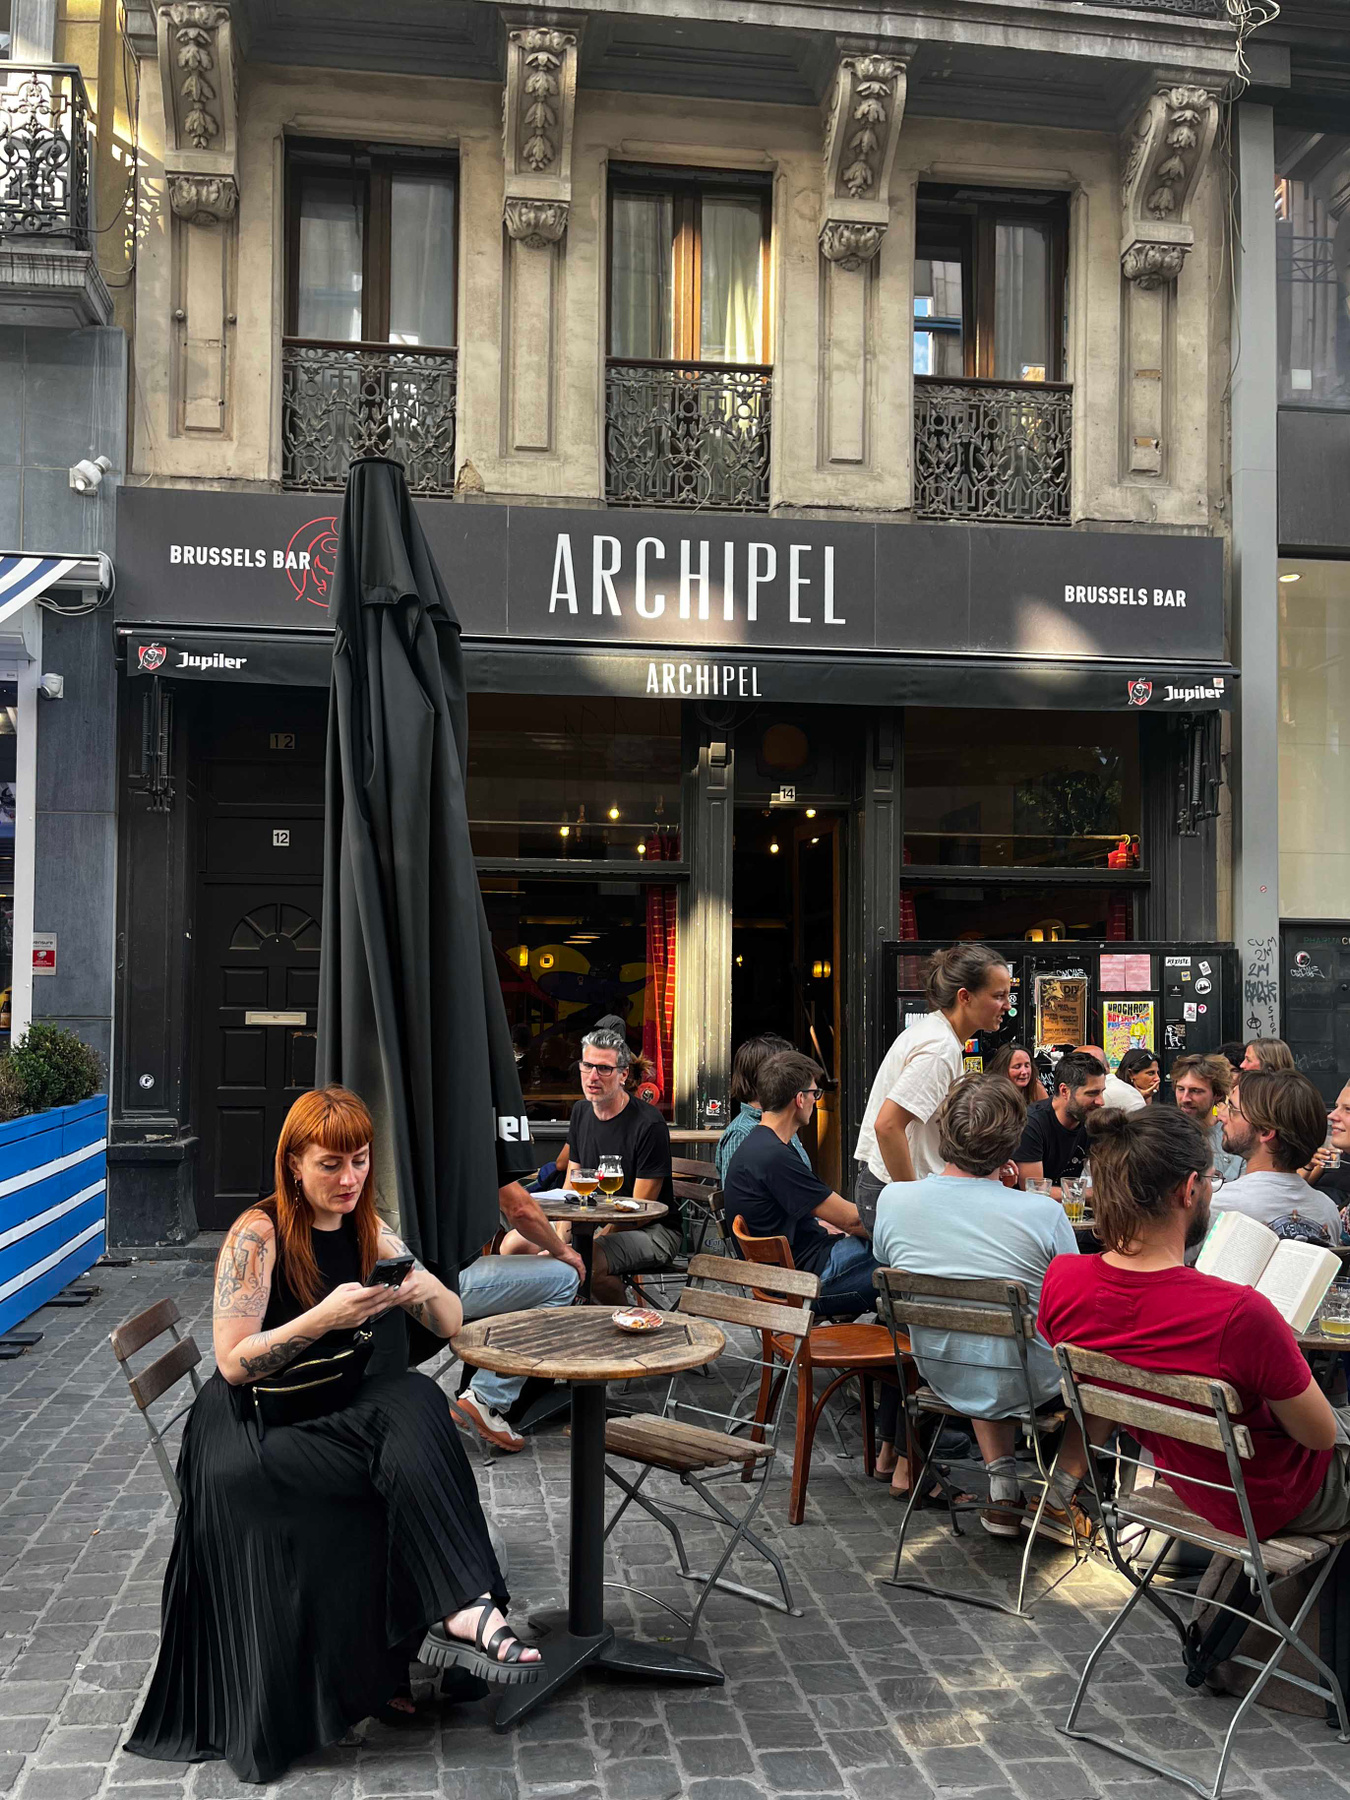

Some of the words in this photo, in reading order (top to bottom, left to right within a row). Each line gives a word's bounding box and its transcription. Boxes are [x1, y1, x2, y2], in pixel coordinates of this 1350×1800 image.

[170, 545, 266, 568] BRUSSELS
[272, 550, 311, 570] BAR
[549, 533, 846, 625] ARCHIPEL
[1064, 585, 1148, 606] BRUSSELS
[1153, 589, 1187, 607] BAR
[176, 651, 247, 671] Jupiler
[646, 662, 763, 697] ARCHIPEL
[1163, 685, 1225, 703] Jupiler
[274, 734, 294, 749] 12
[781, 788, 795, 799] 14
[274, 832, 289, 844] 12
